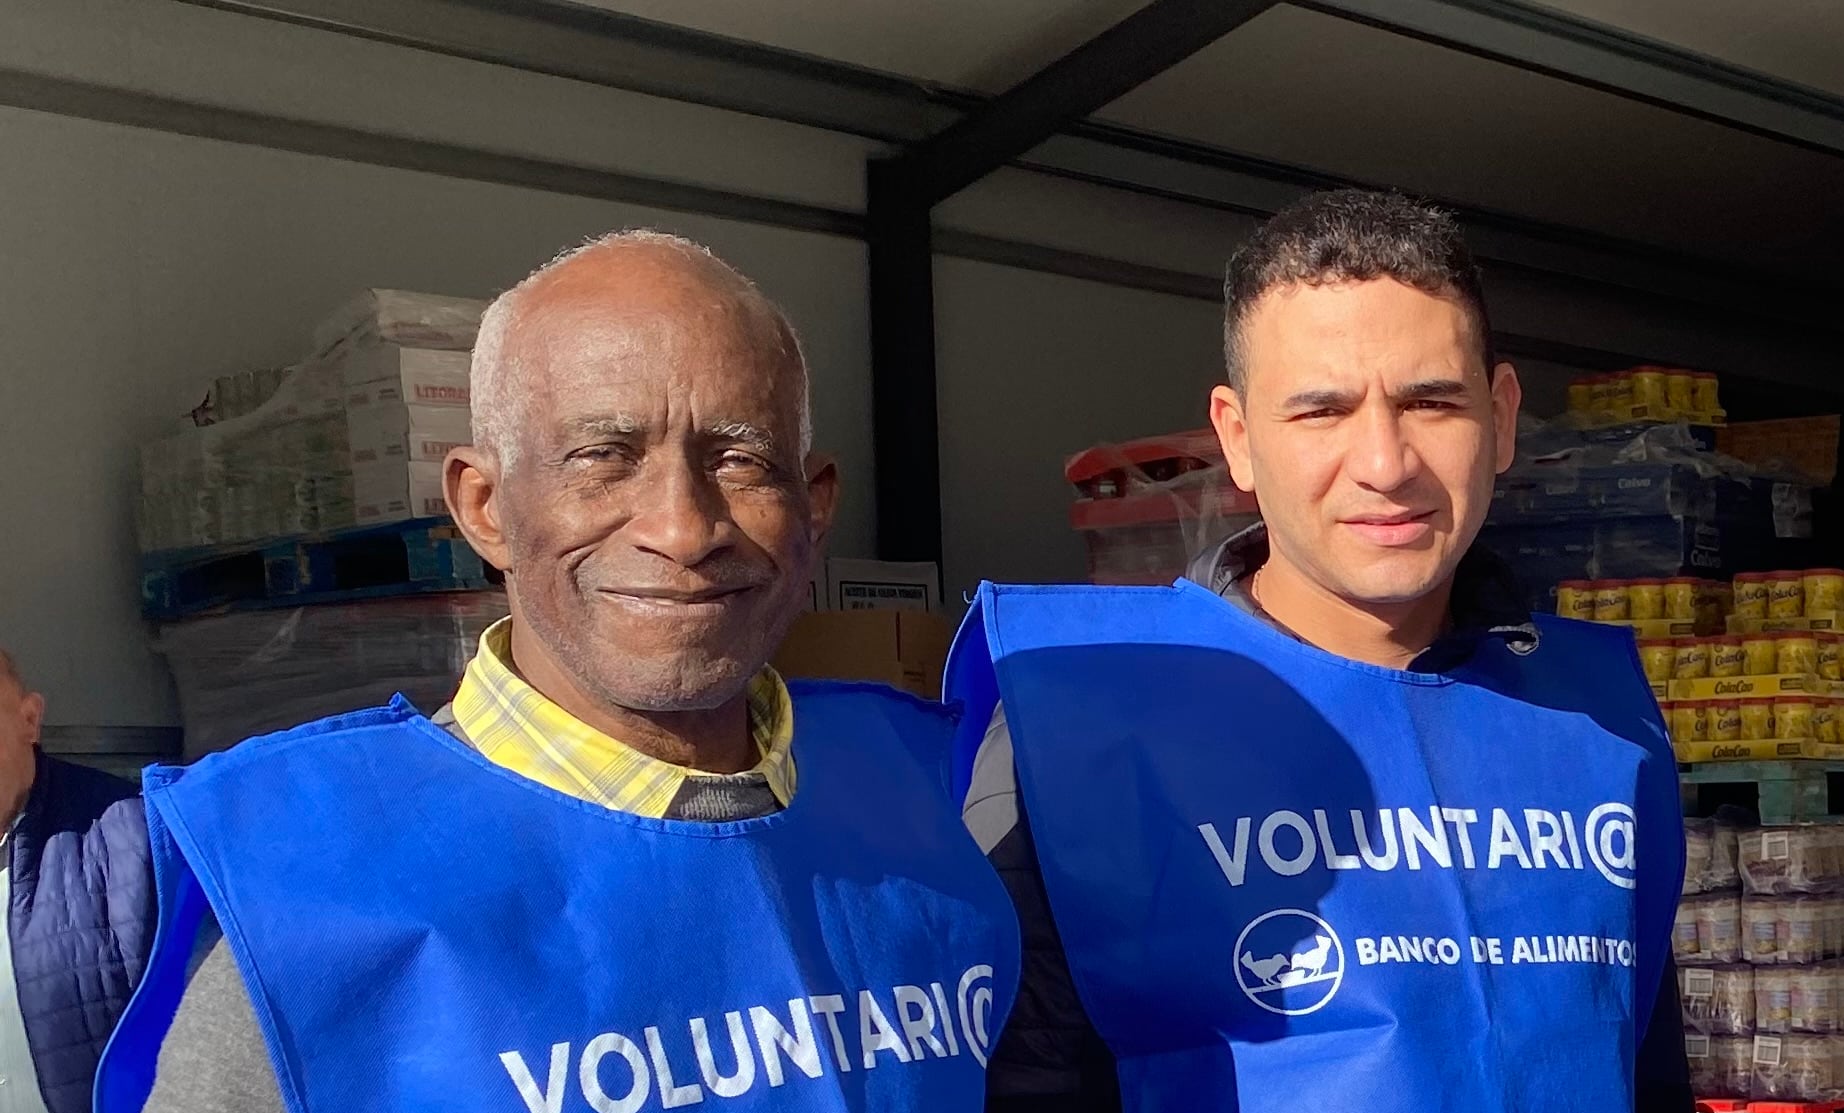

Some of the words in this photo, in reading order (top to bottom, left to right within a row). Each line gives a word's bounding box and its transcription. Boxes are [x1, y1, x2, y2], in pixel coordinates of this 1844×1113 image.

[1714, 680, 1754, 695] ColaCao
[1711, 744, 1751, 758] ColaCao
[1198, 802, 1636, 890] VOLUNTARI@
[1356, 936, 1461, 967] BANCO
[1472, 935, 1503, 965] DE
